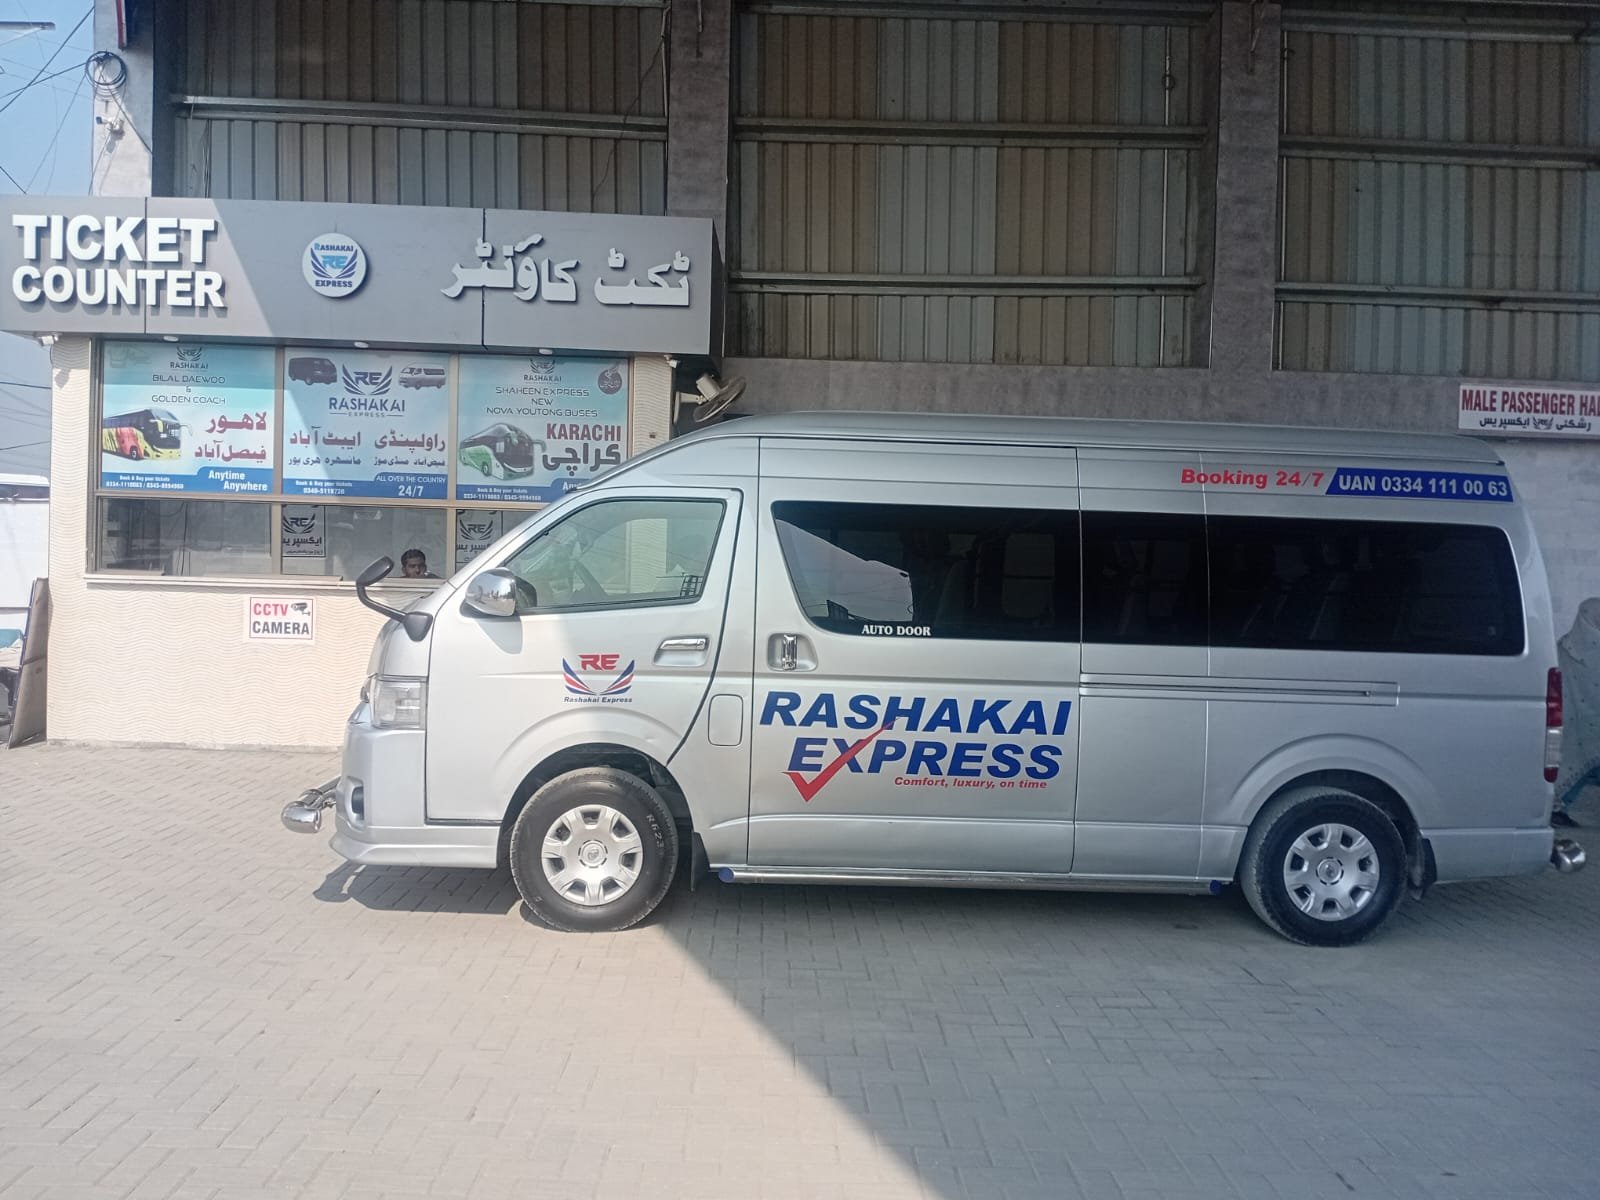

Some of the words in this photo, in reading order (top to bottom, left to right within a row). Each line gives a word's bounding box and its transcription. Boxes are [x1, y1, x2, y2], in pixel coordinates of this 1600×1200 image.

[12, 214, 216, 263] TICKET
[314, 243, 353, 252] RASHAKAI
[594, 248, 690, 306] ٹکٹ
[12, 265, 225, 308] COUNTER
[152, 374, 180, 383] BILAL
[182, 375, 226, 384] DAEWOO
[353, 371, 383, 386] RE
[543, 388, 590, 397] EXPRESS
[151, 395, 191, 404] GOLDEN
[192, 396, 226, 405] COACH
[329, 397, 405, 412] RASHAKAI
[531, 398, 553, 406] NEW
[1461, 389, 1497, 412] MALE
[1501, 391, 1576, 416] PASSENGER
[486, 407, 513, 415] NOVA
[515, 408, 563, 416] YOUTONG
[546, 423, 621, 442] KARACHI
[542, 443, 621, 477] کراچی
[208, 470, 246, 481] Anytime
[1181, 469, 1268, 488] Booking
[1276, 472, 1324, 487] 24/7
[224, 480, 268, 492] Anywhere
[398, 485, 424, 497] 24/7
[1338, 474, 1376, 491] UAN
[1381, 475, 1423, 493] 0334
[1428, 478, 1457, 494] 111
[1463, 479, 1484, 495] 00
[1488, 480, 1508, 497] 63
[253, 603, 289, 616] CCTV
[252, 621, 310, 635] CAMERA
[861, 624, 893, 635] AUTO
[896, 625, 931, 636] DOOR
[577, 654, 620, 671] RE
[601, 696, 633, 704] Express
[759, 691, 1072, 736] RASHAKAI
[787, 737, 1063, 780] EXPRESS
[894, 776, 948, 788] Comfort,
[953, 778, 995, 789] luxury,
[999, 780, 1015, 788] on
[1019, 779, 1047, 789] time
